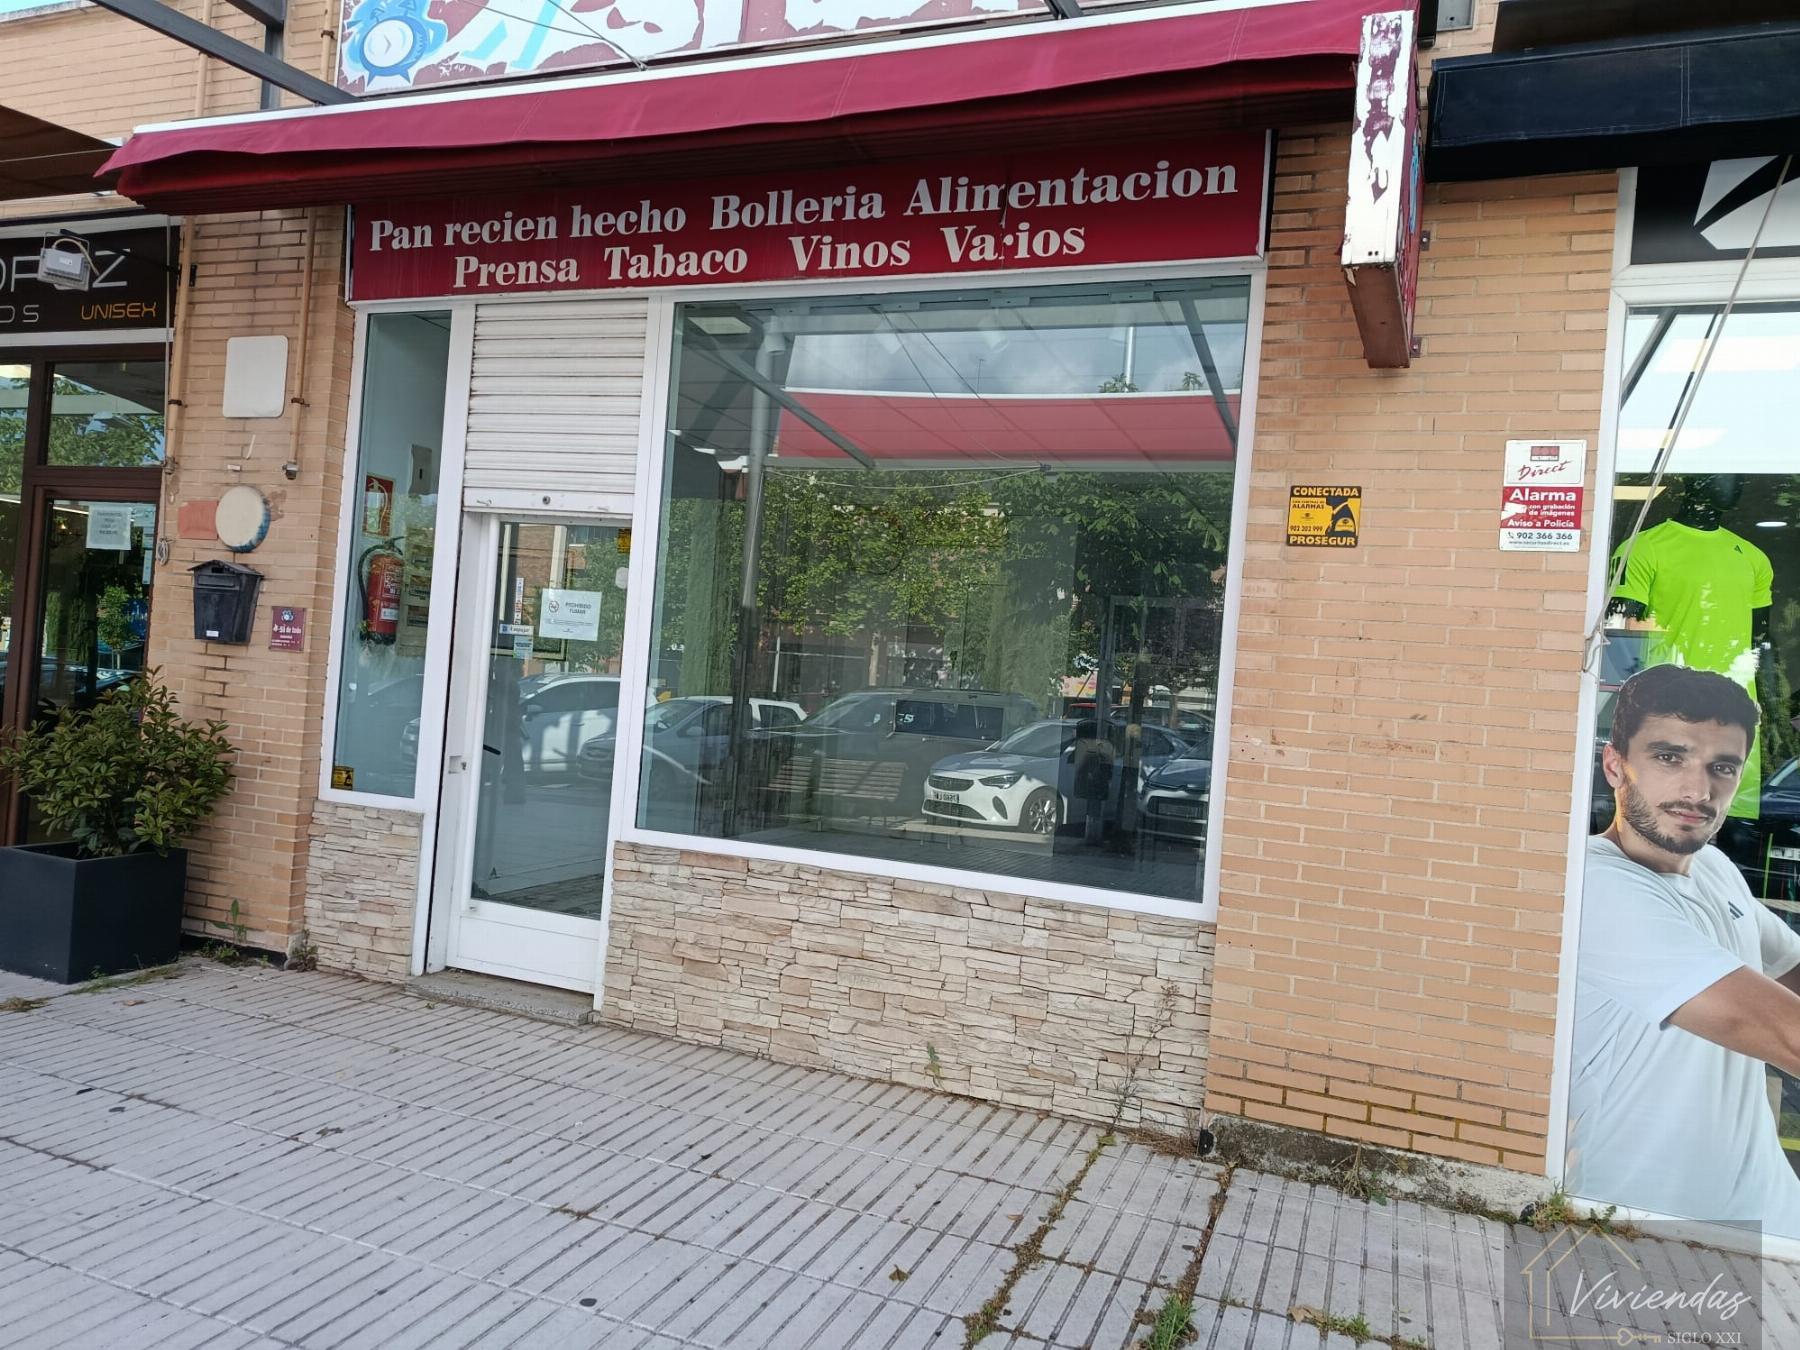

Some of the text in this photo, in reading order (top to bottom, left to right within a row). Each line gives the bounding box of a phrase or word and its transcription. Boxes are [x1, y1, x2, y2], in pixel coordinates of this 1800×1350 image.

[369, 160, 1238, 251] Pan recien hecho Bolleria Alimentacion
[453, 222, 1086, 287] Prensa Tabaco Vinos Varios
[81, 302, 157, 320] UNISEX
[1518, 460, 1572, 481] Direct
[1293, 487, 1359, 496] CONECTADA
[1509, 488, 1577, 501] Alarma
[1507, 519, 1533, 527] Aviso
[1289, 536, 1356, 546] PROSEGUR
[1536, 532, 1553, 540] 366
